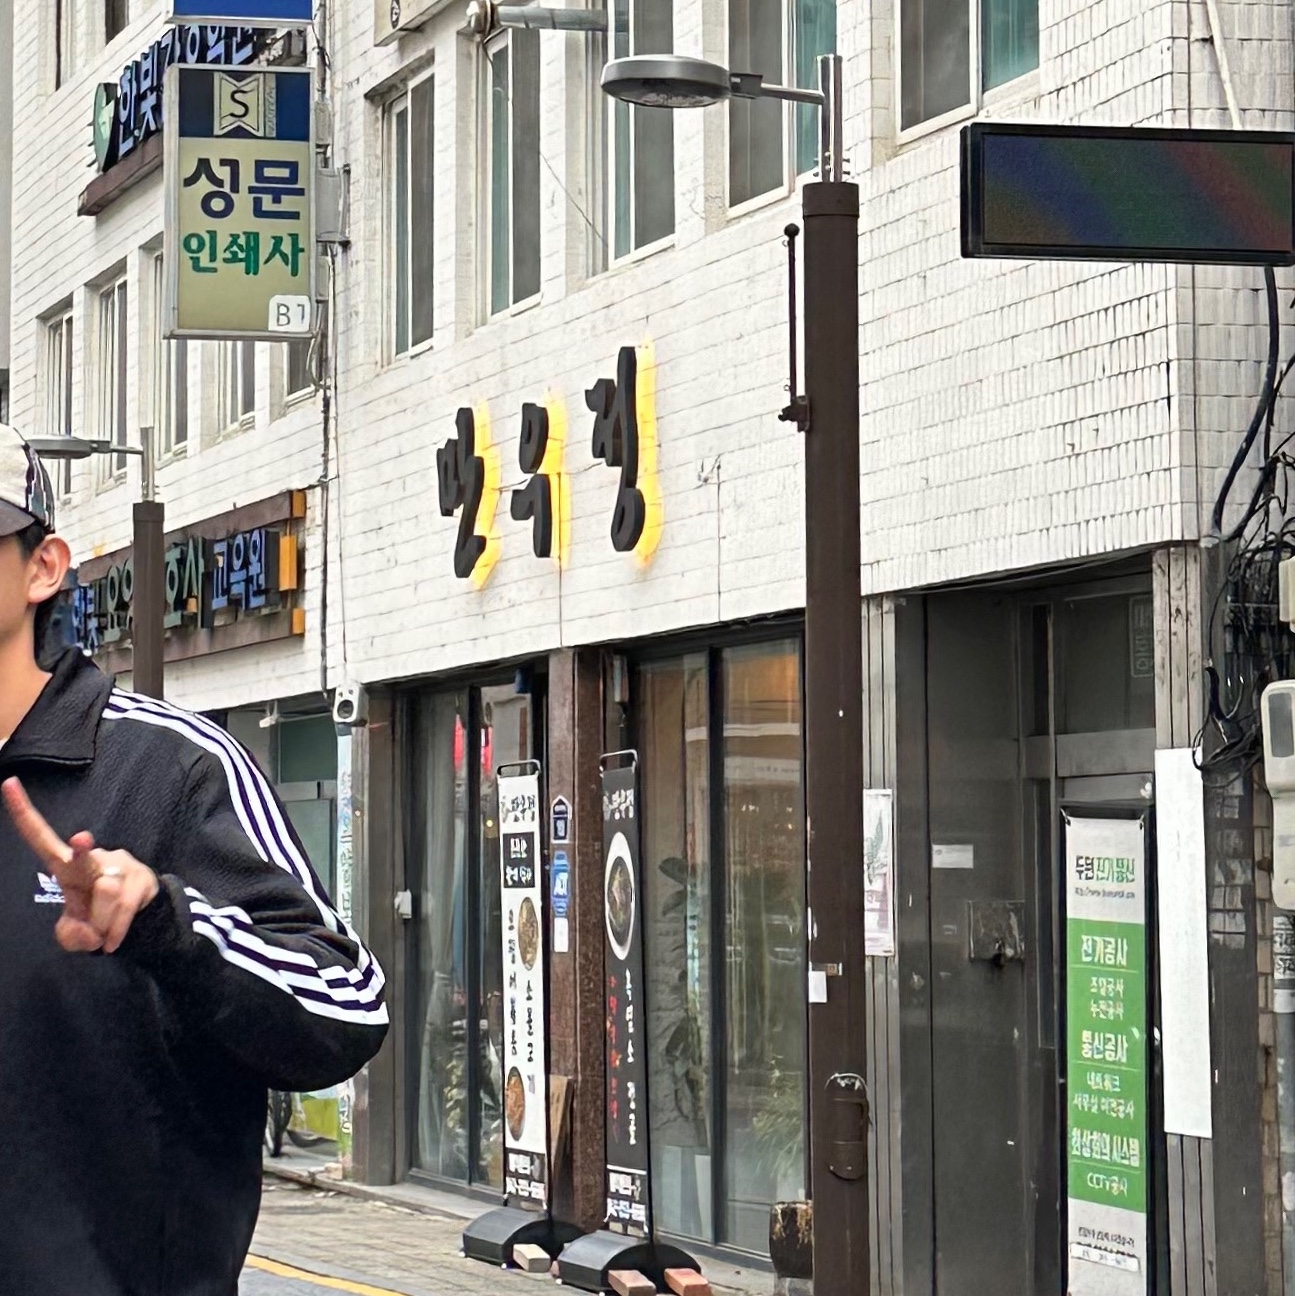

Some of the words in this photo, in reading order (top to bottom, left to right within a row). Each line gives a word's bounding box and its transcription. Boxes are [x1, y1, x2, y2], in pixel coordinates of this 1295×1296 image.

[182, 157, 306, 220] 성문
[182, 229, 306, 278] 인쇄사
[211, 527, 267, 613] 교육원
[1081, 934, 1128, 967] 전기공사
[1081, 1030, 1129, 1063] 통신공사
